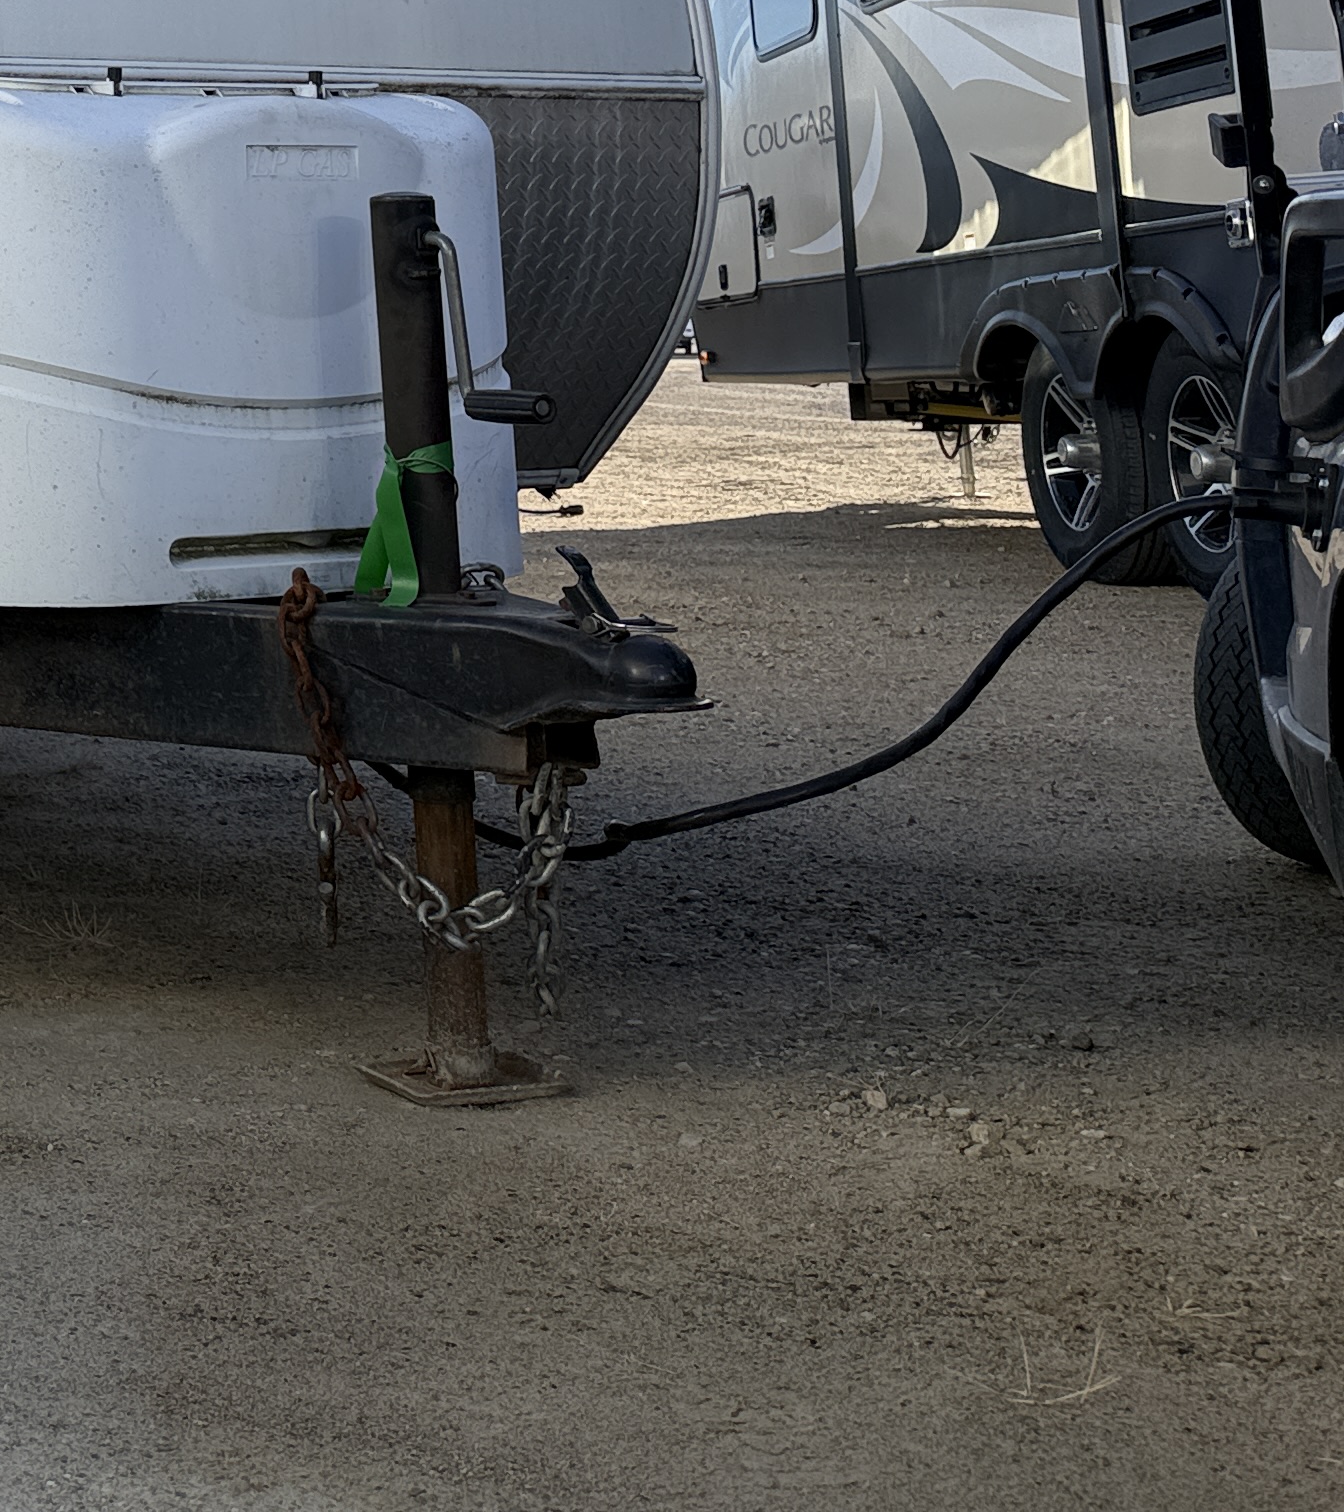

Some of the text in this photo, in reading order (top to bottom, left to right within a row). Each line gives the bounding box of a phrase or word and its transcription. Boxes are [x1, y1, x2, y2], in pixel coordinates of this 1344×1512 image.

[743, 105, 834, 158] COUGAR
[251, 148, 352, 178] LP GAS
